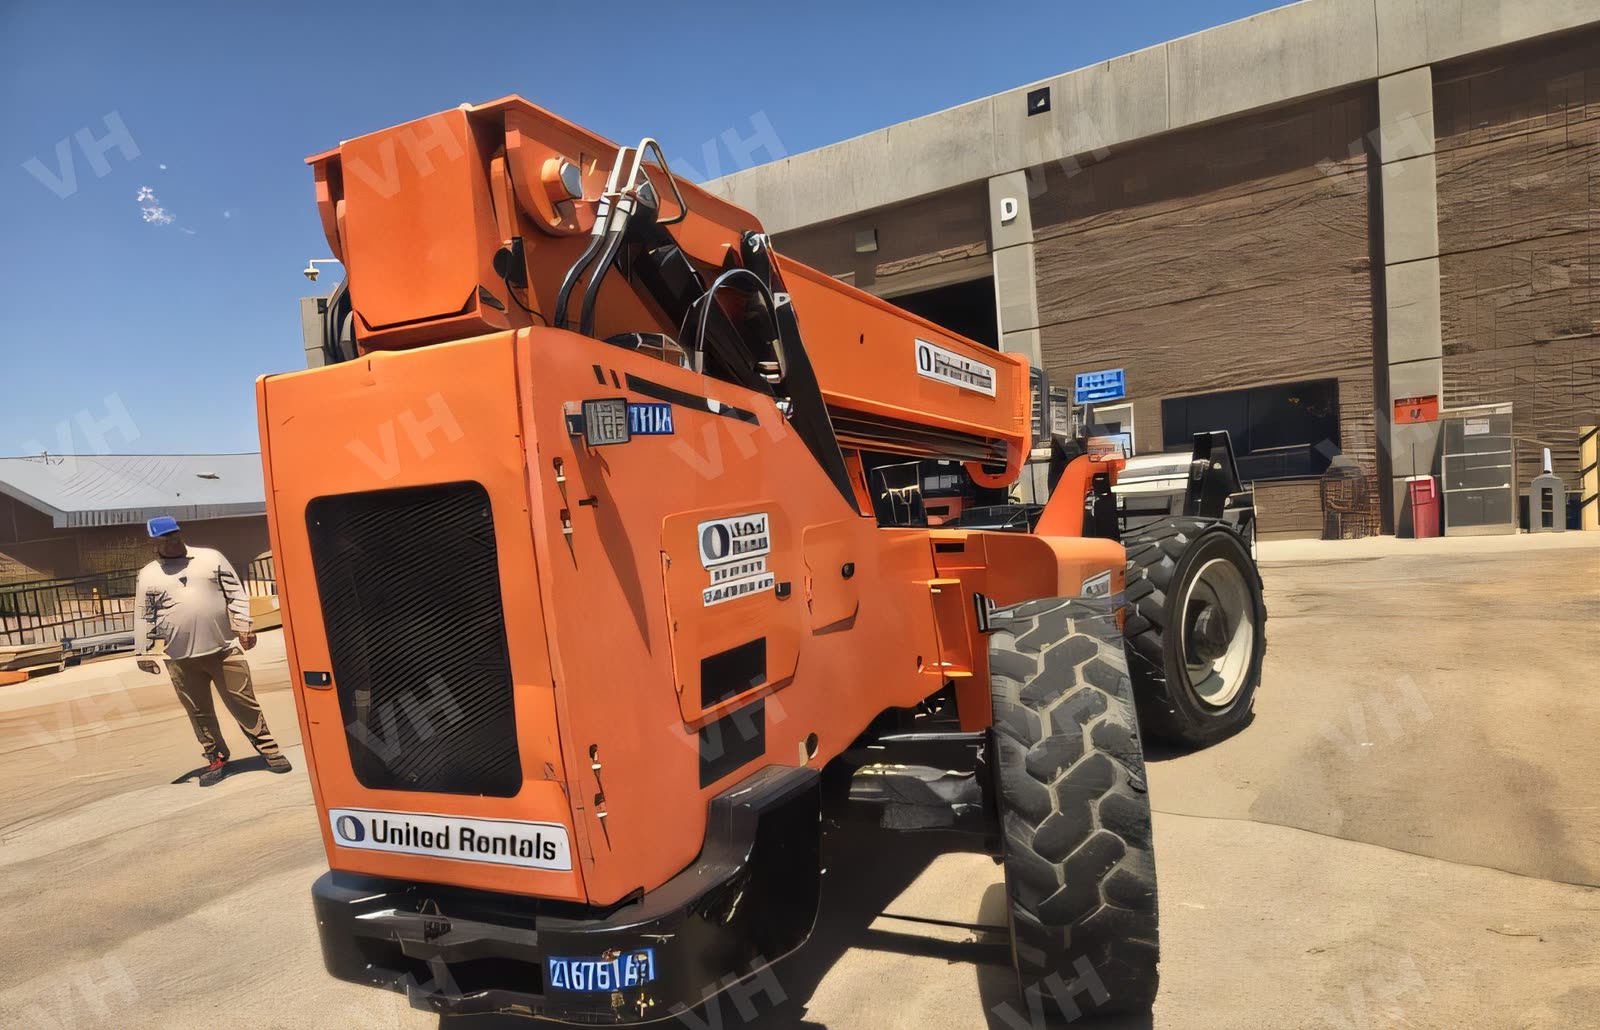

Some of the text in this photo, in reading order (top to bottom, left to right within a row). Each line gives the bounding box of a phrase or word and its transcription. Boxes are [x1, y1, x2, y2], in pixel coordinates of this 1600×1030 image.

[1001, 197, 1018, 221] D
[372, 819, 556, 861] United Rentals
